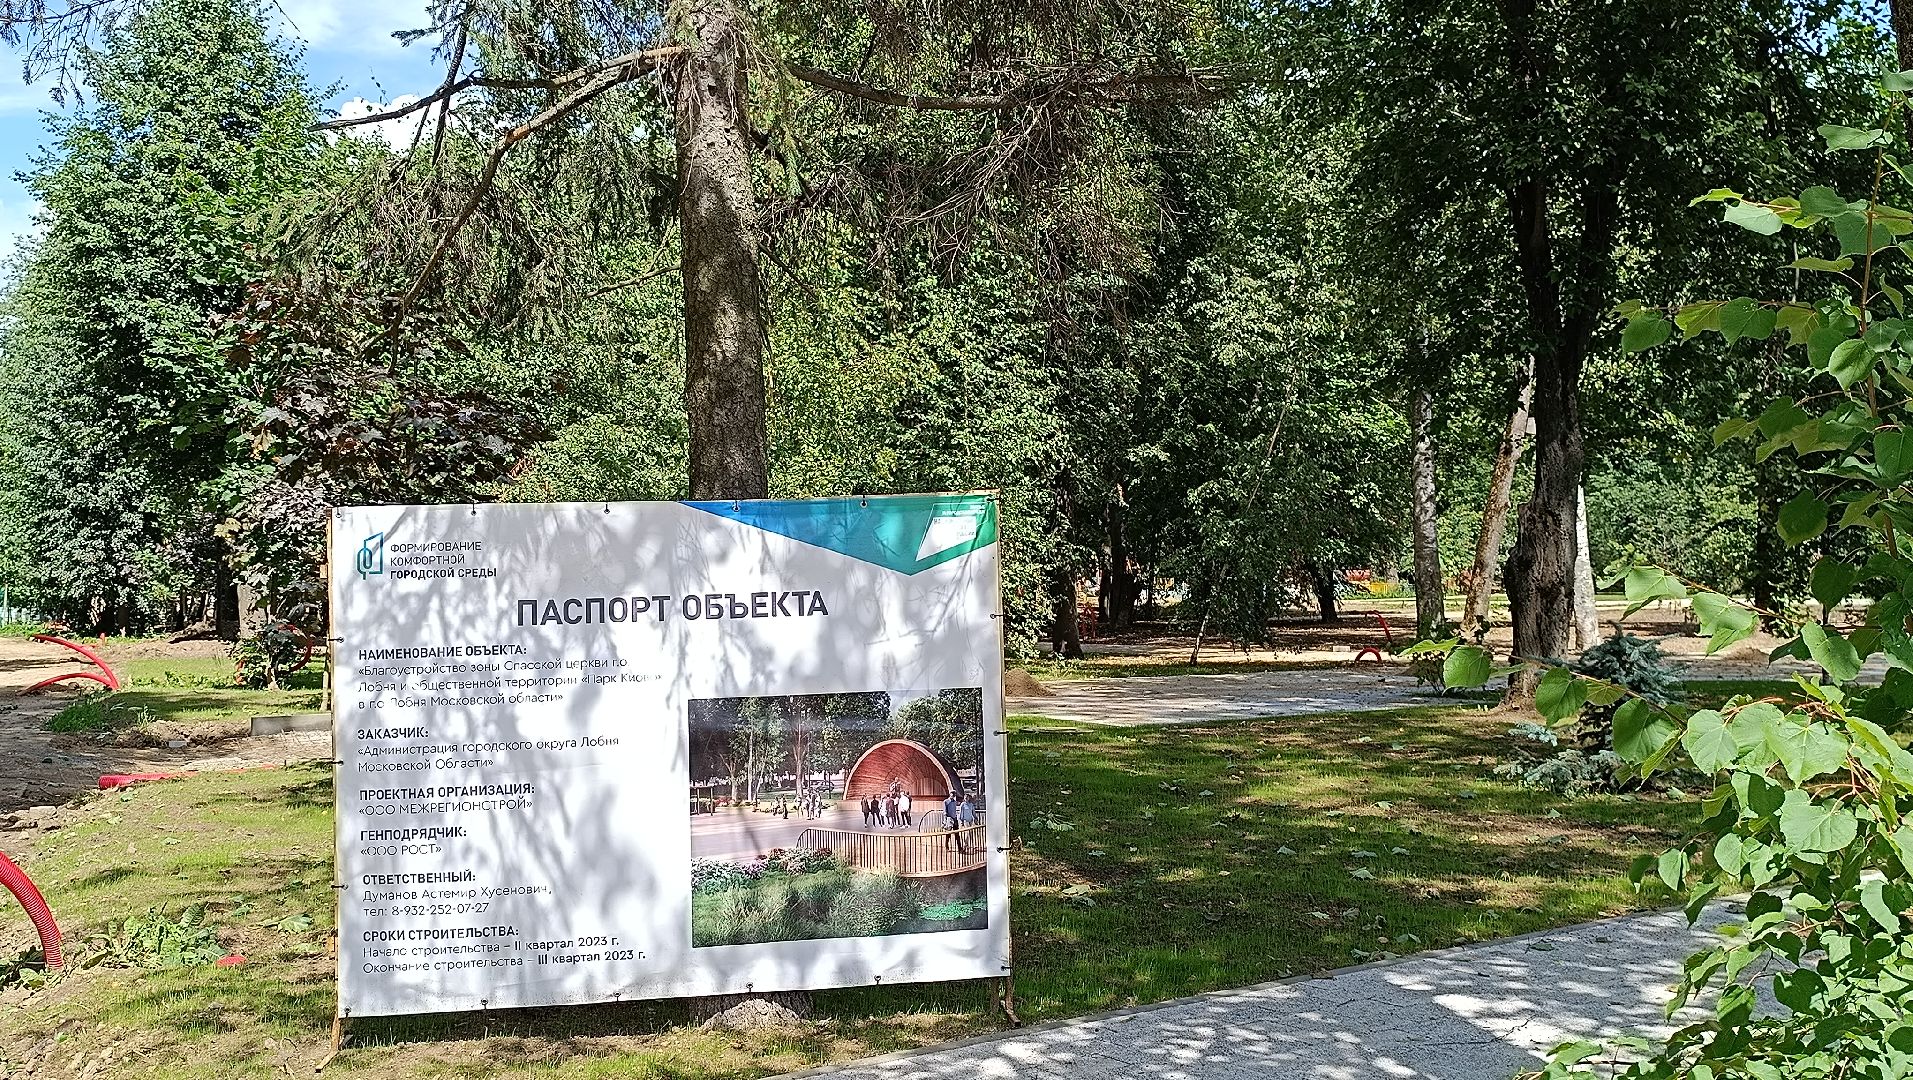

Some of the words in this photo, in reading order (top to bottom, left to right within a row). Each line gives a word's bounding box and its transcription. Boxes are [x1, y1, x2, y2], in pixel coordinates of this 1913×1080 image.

[390, 541, 482, 553] ФОРМИРОВАНИЕ
[390, 554, 465, 567] КОМФОРТНОЙ
[390, 567, 455, 580] ГОРОДСКОЙ
[457, 567, 497, 579] СРЕДЫ
[517, 595, 671, 626] ПАСПОРТ
[682, 590, 829, 621] ОБЪЕКТА
[358, 646, 463, 661] НАИМЕНОВАНИЕ
[465, 644, 527, 657] ОБЪЕКТА:
[358, 662, 467, 678] «Благоустройство
[470, 663, 500, 673] зоны
[503, 658, 562, 671] Спасской
[565, 658, 608, 671] церкви
[357, 681, 396, 693] Лобня
[400, 683, 408, 691] и
[504, 676, 577, 689] территории
[581, 674, 617, 686] «Парк
[358, 701, 365, 709] в
[430, 692, 505, 706] Московской
[508, 692, 564, 704] области»
[357, 726, 429, 740] ЗАКАЗЧИК:
[357, 742, 458, 757] «Администрация
[462, 740, 533, 753] городского
[536, 739, 577, 751] округа
[580, 735, 619, 748] Лобня
[358, 758, 431, 772] Московской
[435, 757, 494, 770] Области»
[359, 787, 434, 801] ПРОЕКТНАЯ
[437, 783, 535, 798] ОРГАНИЗАЦИЯ:
[358, 804, 396, 816] «ООО
[399, 795, 533, 814] МЕЖРЕГИОНСТРОЙ»
[360, 826, 467, 842] ГЕНПОДРЯДЧИК:
[360, 845, 398, 857] «ООО
[401, 843, 442, 856] РОСТ»
[362, 868, 476, 885] ОТВЕТСТВЕННЫЙ:
[362, 889, 418, 903] Думанов
[421, 888, 477, 900] Астемир
[480, 884, 552, 899] Хусенович,
[363, 906, 388, 917] тел:
[391, 902, 490, 917] 8-932-252-07-27
[363, 929, 406, 942] СРОКИ
[408, 925, 519, 941] СТРОИТЕЛЬСТВА:
[363, 947, 407, 958] Начало
[411, 943, 500, 957] строительства
[514, 940, 521, 951] II
[525, 939, 574, 952] квартал
[578, 936, 608, 947] 2023
[611, 937, 620, 946] г.
[362, 962, 430, 974] Окончание
[434, 957, 523, 972] строительства
[537, 953, 548, 965] III
[552, 953, 600, 965] квартал
[604, 949, 634, 961] 2023
[638, 951, 646, 960] г.
